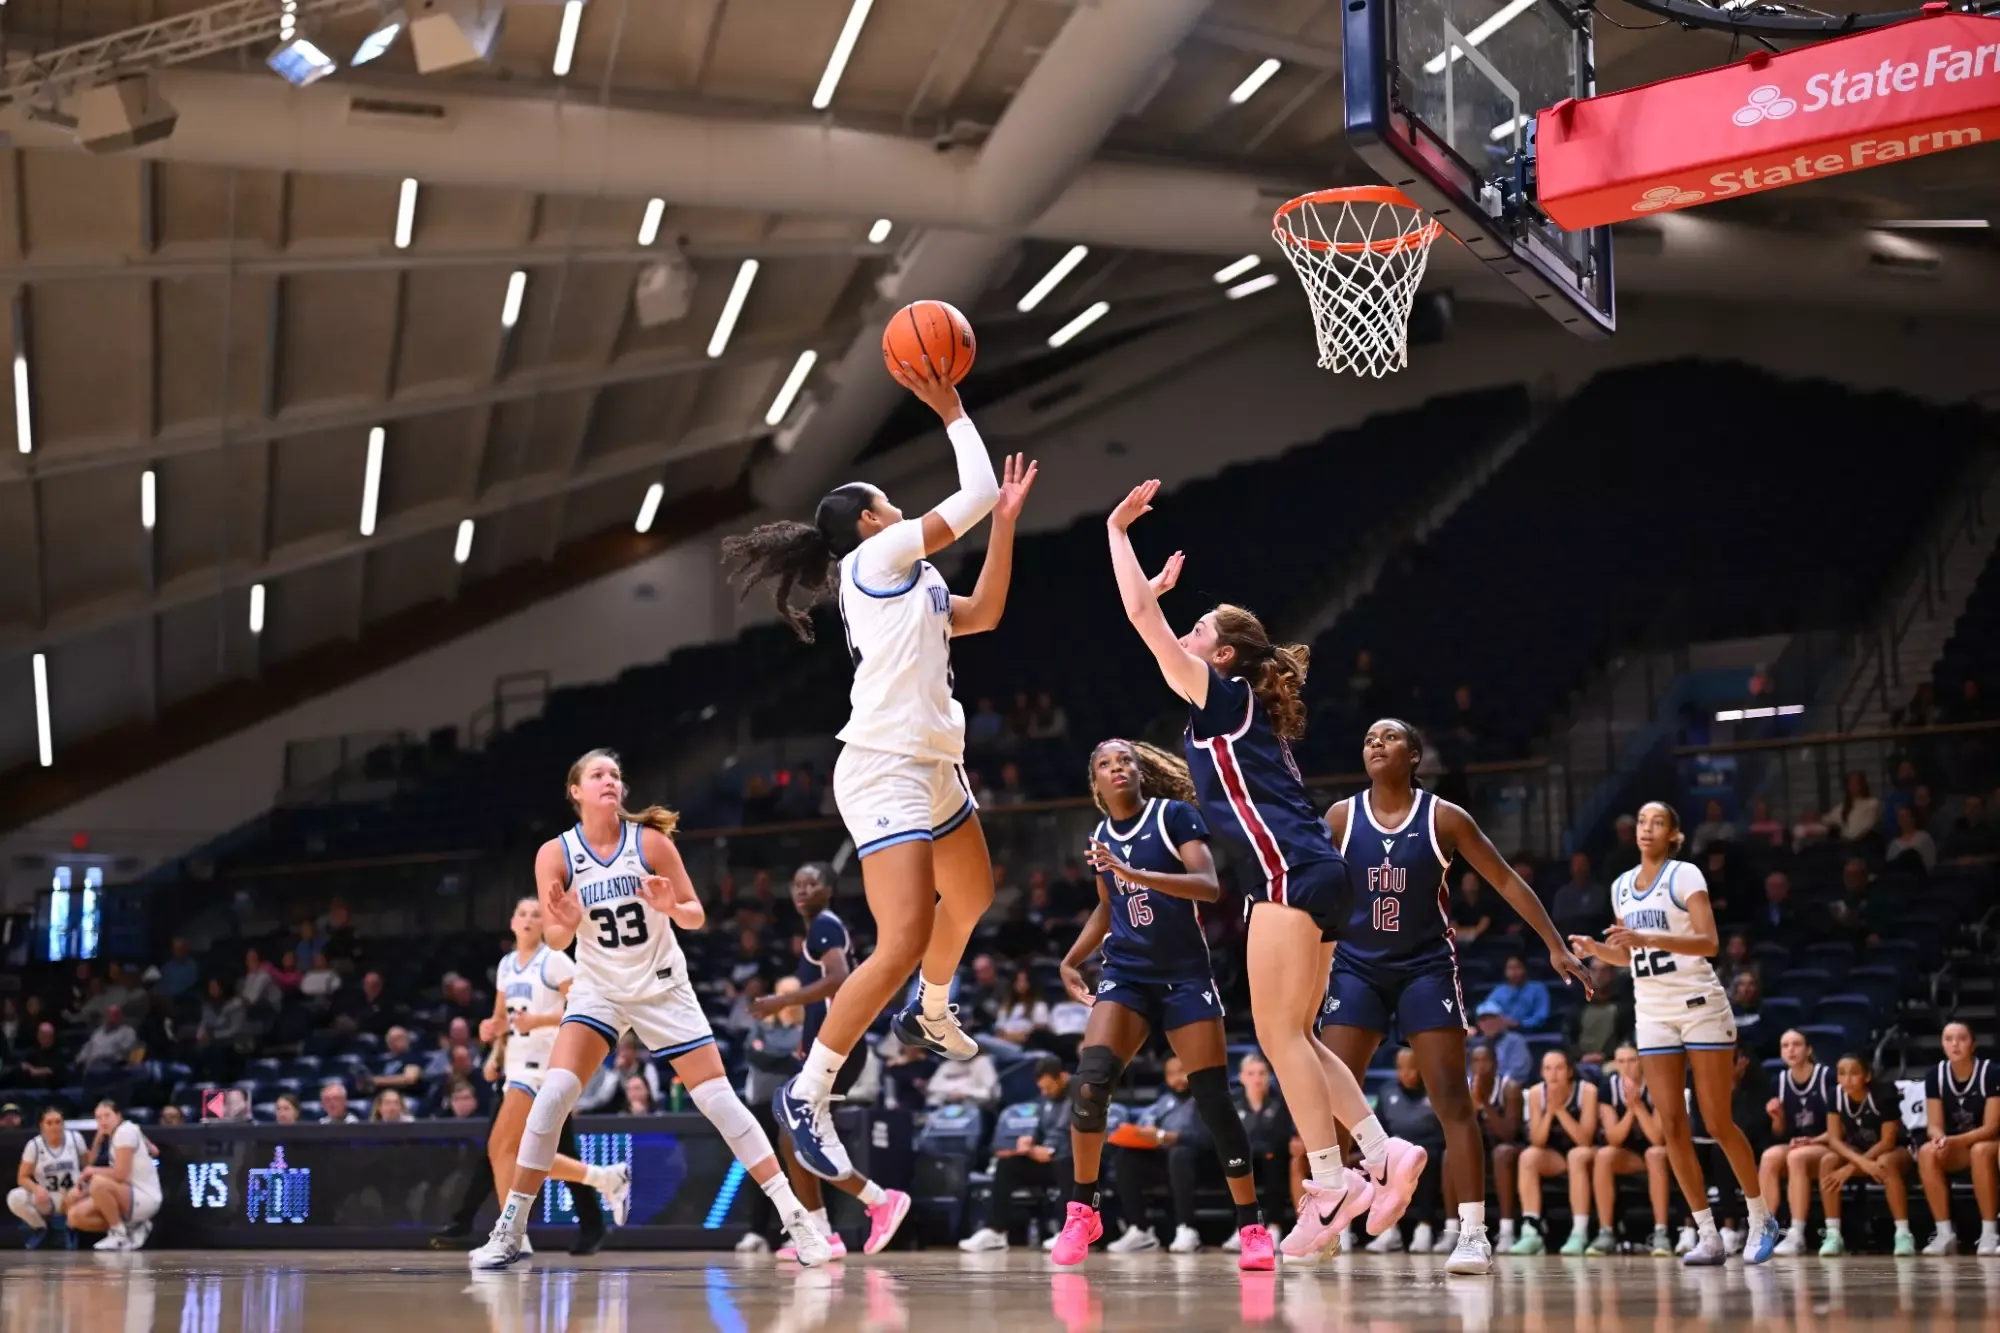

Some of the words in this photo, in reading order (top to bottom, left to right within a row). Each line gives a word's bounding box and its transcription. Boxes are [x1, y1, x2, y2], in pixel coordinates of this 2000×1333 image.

[1367, 867, 1406, 893] FDU
[589, 902, 649, 949] 33
[1127, 893, 1154, 928] 15
[1372, 897, 1400, 932] 12
[45, 1172, 74, 1192] 34
[187, 1163, 228, 1208] VS
